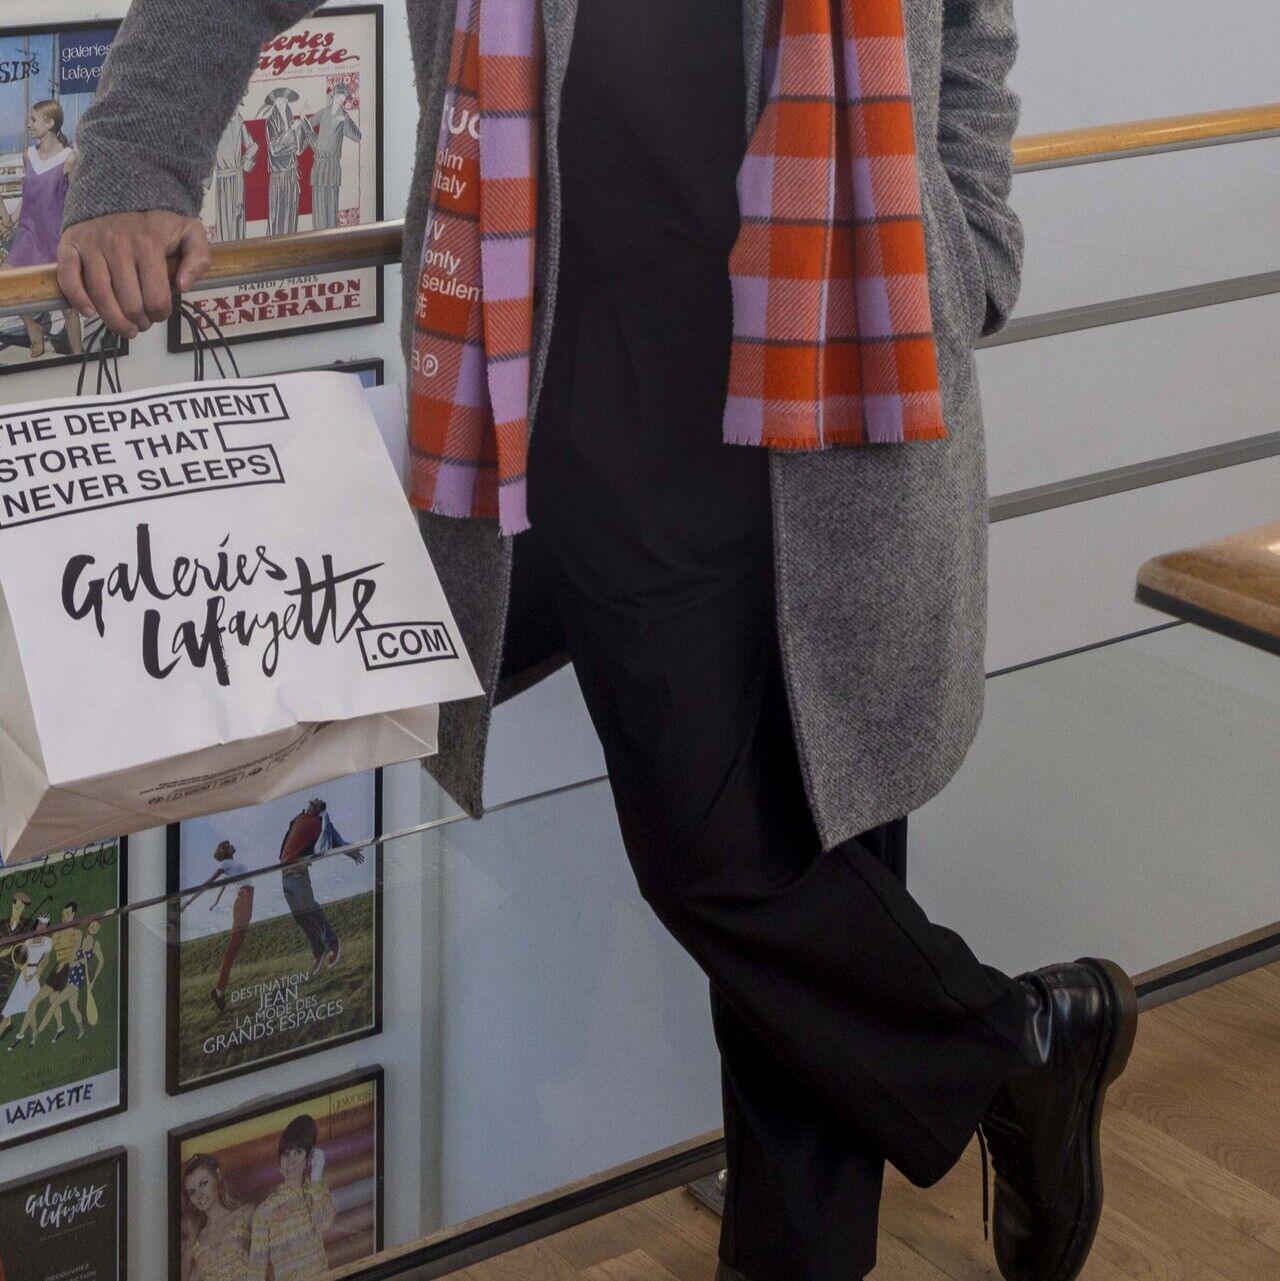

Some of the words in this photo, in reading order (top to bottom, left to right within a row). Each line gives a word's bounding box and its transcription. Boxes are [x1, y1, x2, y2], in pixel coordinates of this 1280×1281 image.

[61, 66, 101, 84] Lafaye
[424, 248, 462, 276] only
[193, 278, 362, 314] EXPOSITION
[63, 392, 271, 437] DEPARTMENT
[125, 428, 210, 465] THAT
[2, 473, 130, 518] NEVER
[136, 454, 272, 492] SLEEPS
[61, 522, 288, 639] Galeries
[142, 554, 385, 687] Lafayette
[371, 627, 448, 661] .COM
[230, 971, 310, 1003] DESTINATION
[259, 984, 299, 1010] JEAN
[201, 1023, 275, 1055] GRANDS
[277, 998, 345, 1033] ESPACES
[234, 1016, 253, 1029] LA
[254, 1003, 294, 1023] MODE
[294, 994, 319, 1013] DES
[5, 1083, 95, 1127] LAFAYETTE
[25, 1183, 80, 1218] Galeries
[40, 1183, 108, 1228] Lafayette
